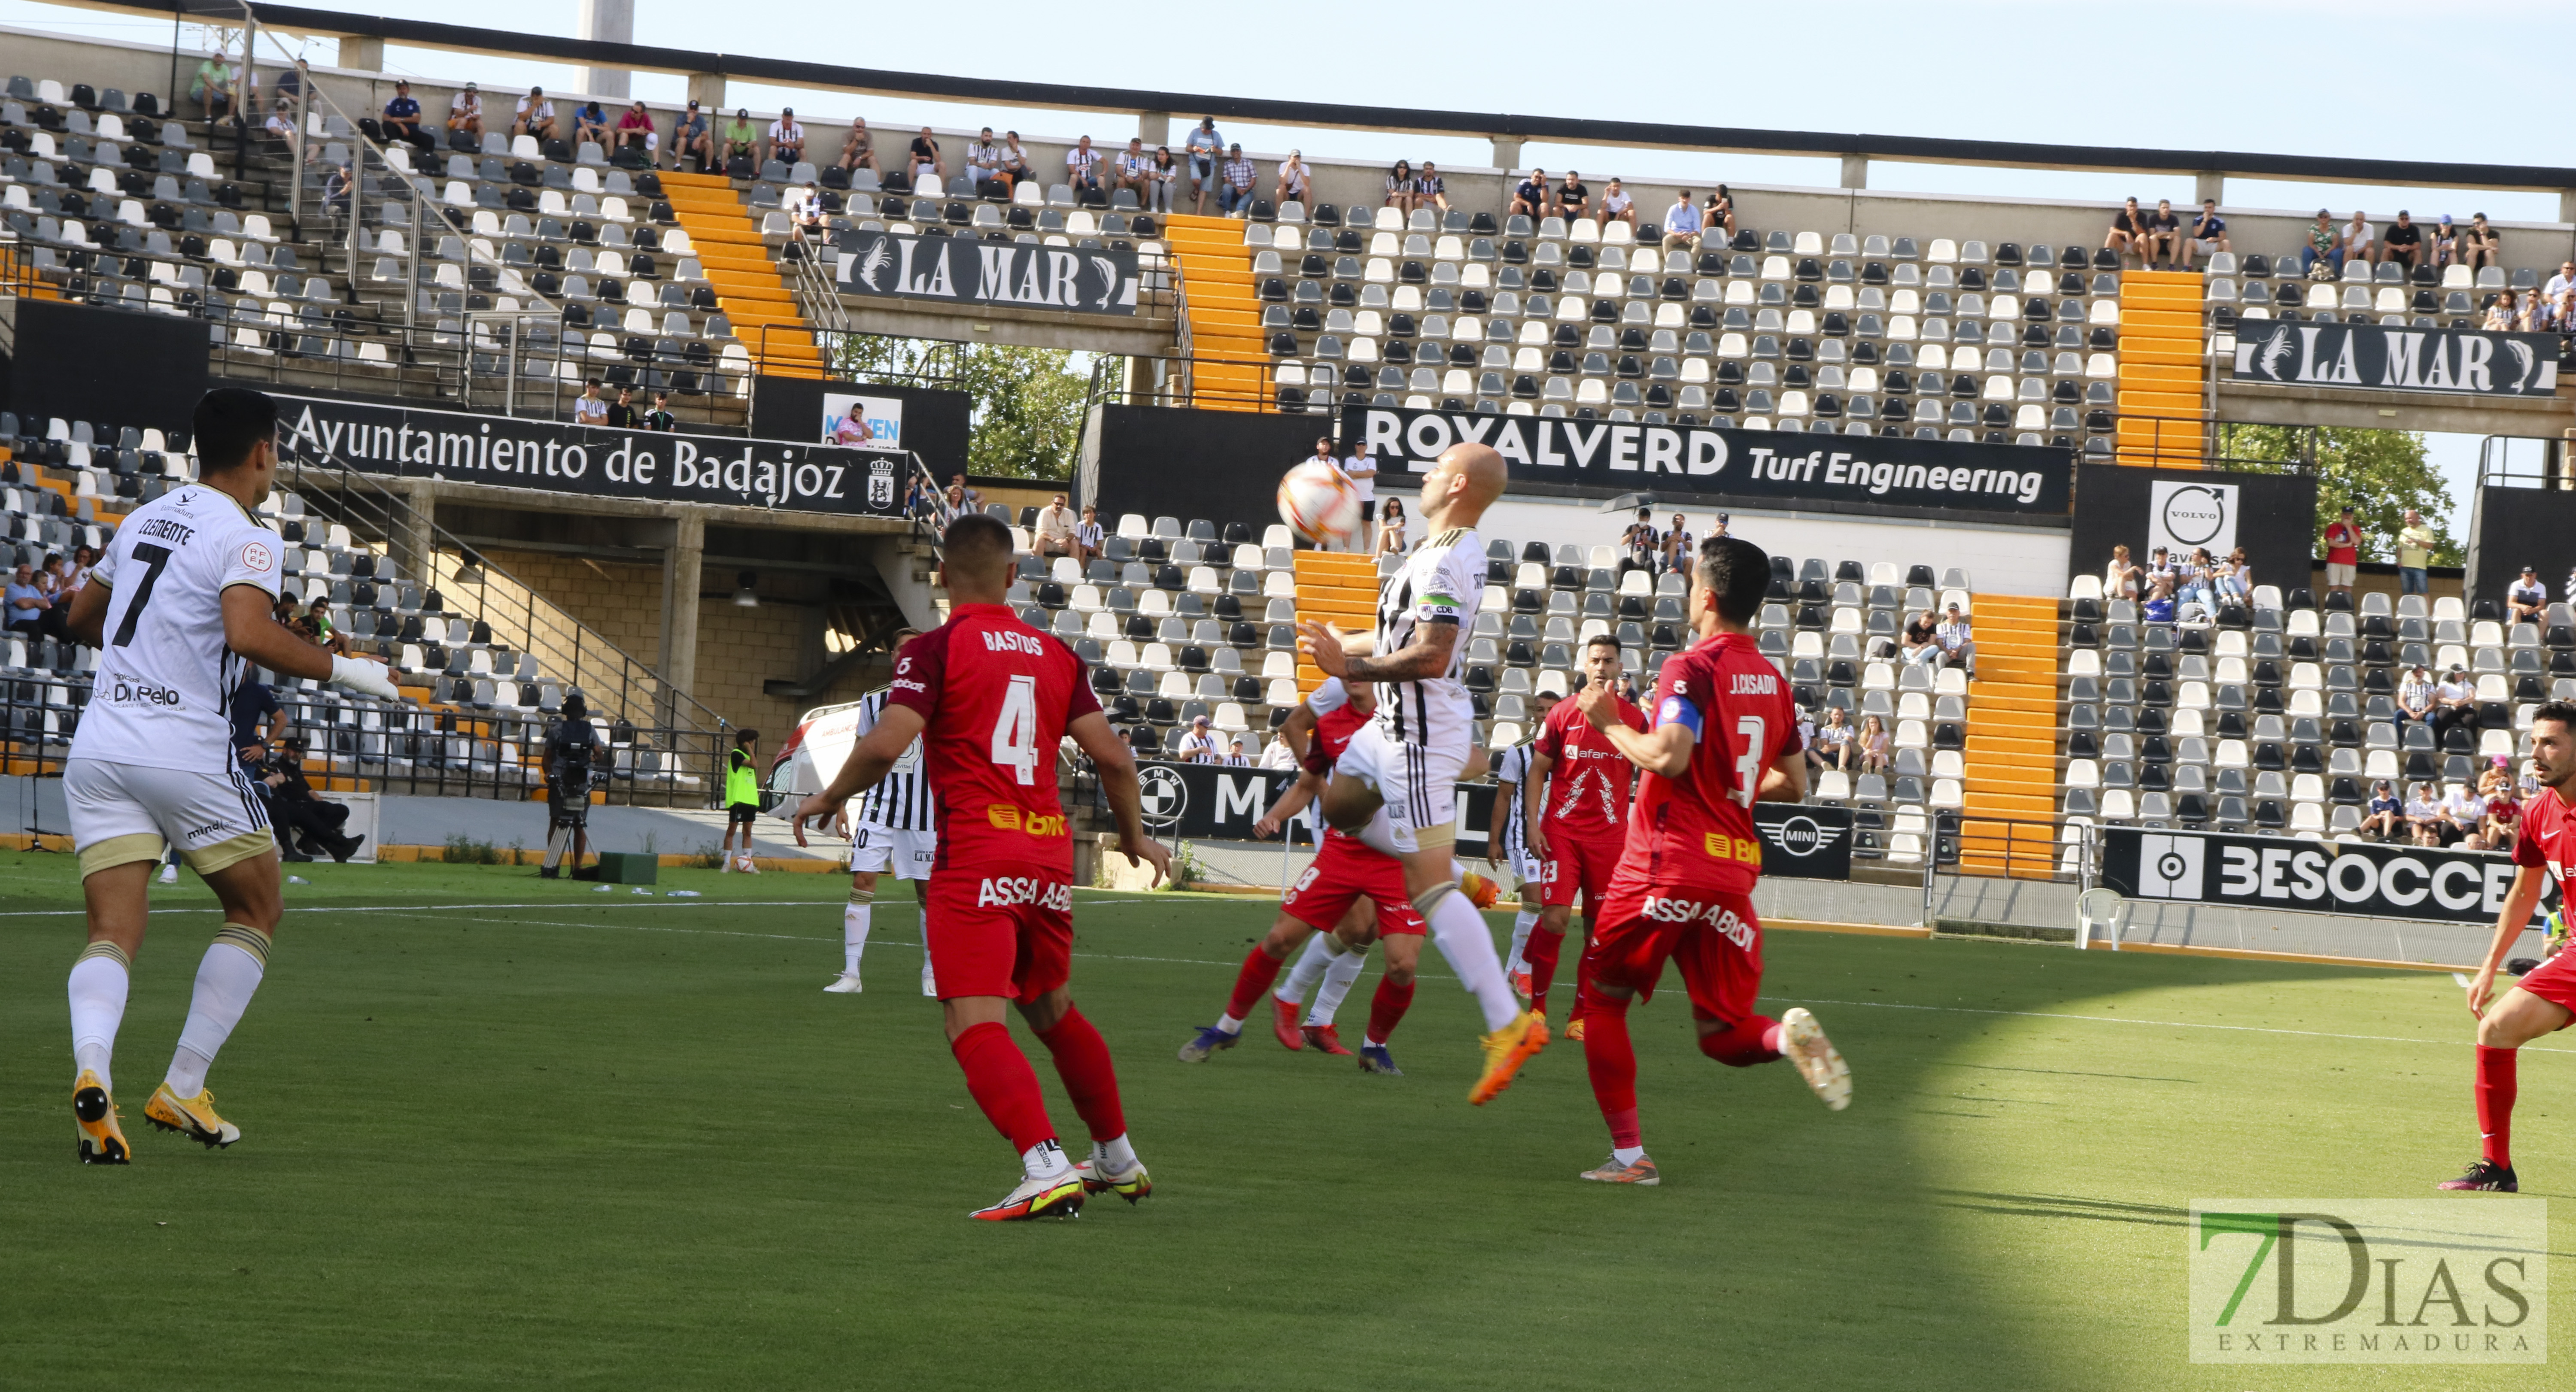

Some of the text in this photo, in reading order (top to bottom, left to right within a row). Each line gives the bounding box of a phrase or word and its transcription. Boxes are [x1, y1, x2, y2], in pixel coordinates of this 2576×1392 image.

[894, 239, 1079, 306] LA MAR
[2295, 328, 2494, 391] LA MAR
[288, 405, 844, 503] Ayuntamiento de Badajoz
[1365, 410, 2042, 503] ROYALVERD Turf Engineering
[161, 505, 194, 519] Extremadura
[2171, 511, 2216, 519] VOLVO
[139, 519, 195, 546] CLEMENTE
[112, 542, 173, 647] 7
[982, 631, 1043, 656] BASTOS
[1729, 674, 1777, 695] J.CASADO
[992, 674, 1039, 785] 4
[1138, 770, 1180, 786] BMW
[1726, 716, 1765, 809] 3
[1786, 830, 1815, 842] MINI
[1542, 860, 1558, 884] 23
[978, 876, 1038, 907] ASSA
[1641, 895, 1756, 952] ASSA ABLOY
